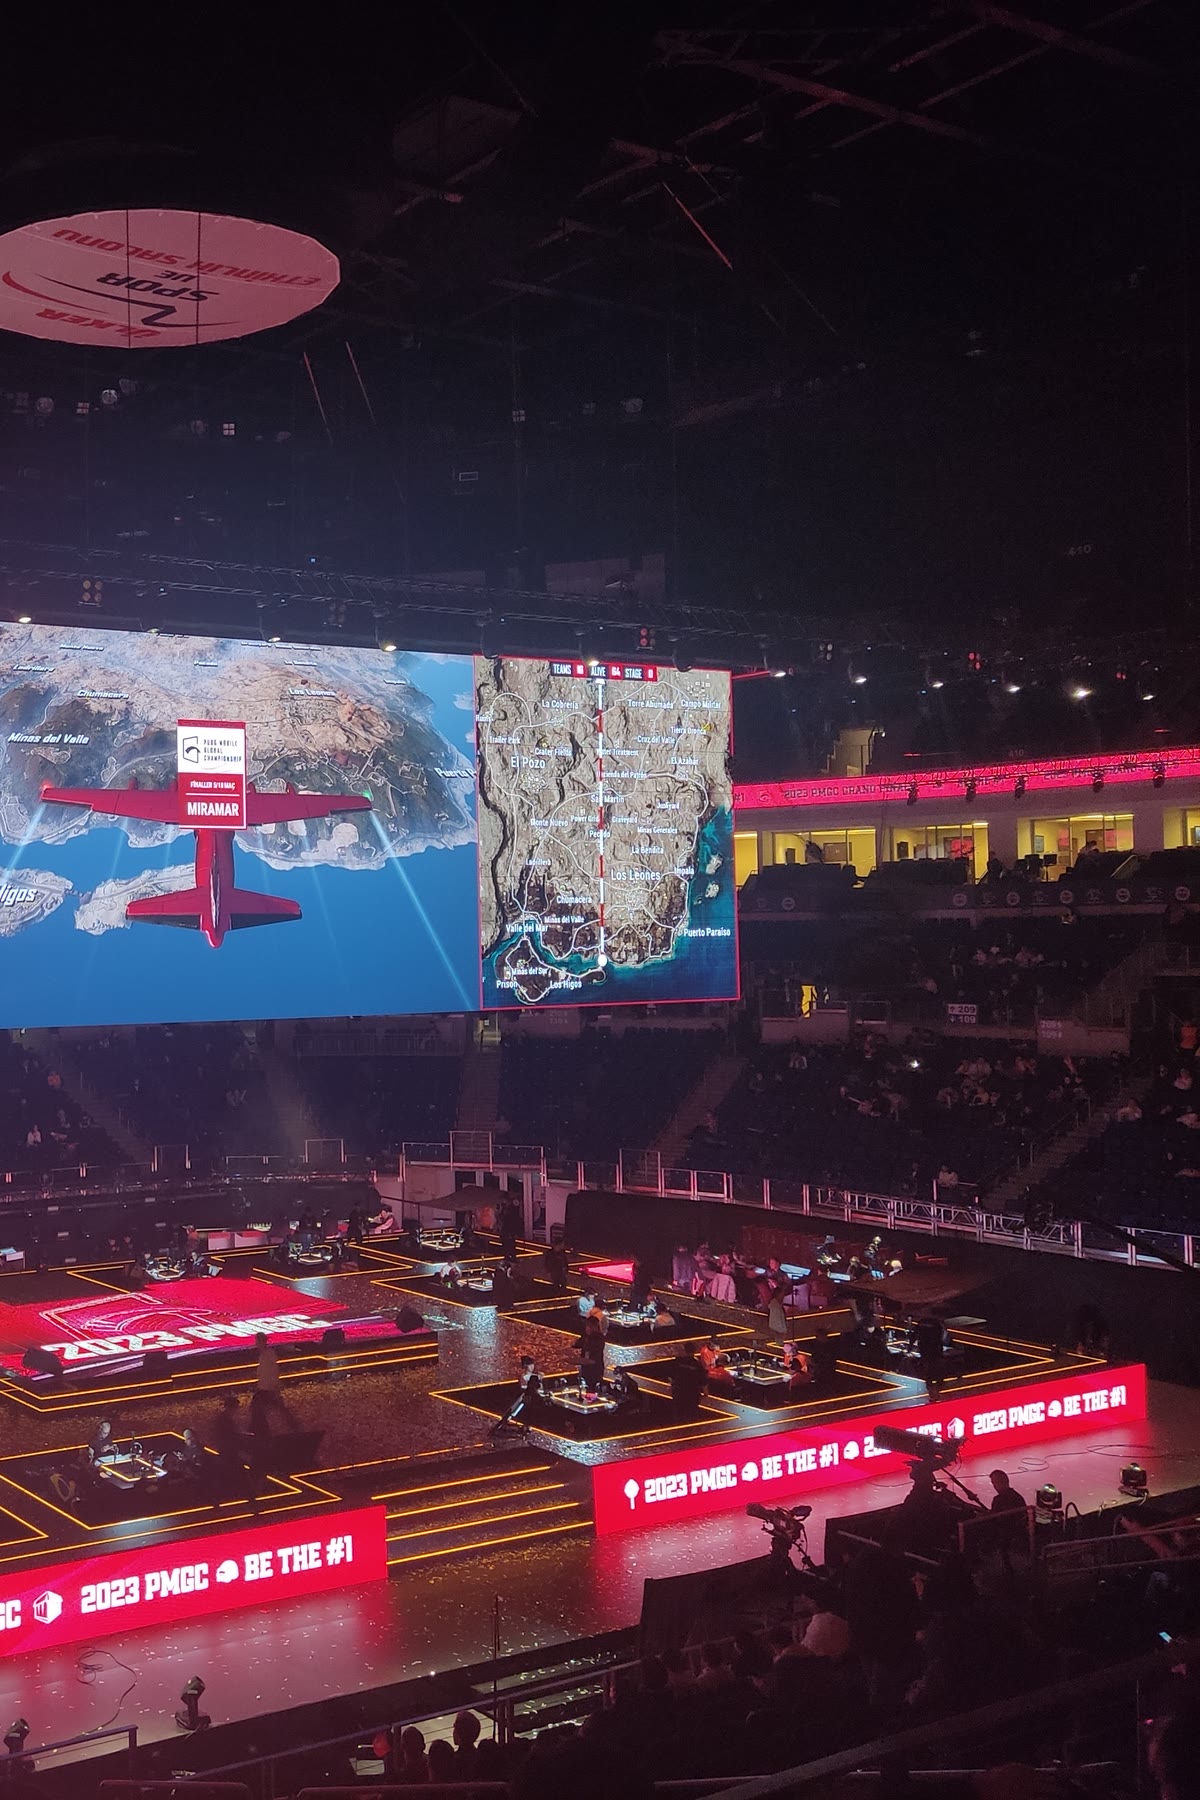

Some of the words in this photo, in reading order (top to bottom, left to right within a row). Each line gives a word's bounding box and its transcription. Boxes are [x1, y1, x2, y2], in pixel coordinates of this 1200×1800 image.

[51, 228, 188, 266] SALONU
[96, 271, 221, 303] SPOR
[35, 308, 161, 339] ÜLKER
[553, 663, 572, 675] TEAMS
[590, 665, 606, 677] ALIVE
[611, 666, 621, 676] 64
[625, 668, 643, 679] STAGE
[542, 699, 551, 708] La
[628, 699, 645, 708] Torre
[645, 700, 674, 709] Ahumada
[680, 700, 701, 709] Campo
[702, 700, 722, 709] Militar
[671, 726, 687, 734] Tierra
[7, 732, 41, 743] Minas
[42, 733, 62, 744] del
[63, 734, 91, 745] Valle
[508, 736, 521, 744] Park
[637, 735, 651, 743] Cruz
[651, 736, 660, 744] del
[660, 736, 676, 744] Valle
[203, 755, 242, 763] CHAMPIONSHIP
[511, 756, 520, 768] El
[522, 757, 546, 769] Pozo
[621, 771, 631, 779] del
[783, 787, 808, 798] 2023
[811, 786, 839, 798] PMGC
[842, 784, 876, 797] GRAND
[187, 801, 240, 817] MIRAMAR
[530, 818, 549, 827] Monte
[549, 819, 569, 827] Nuevo
[570, 815, 588, 823] Power
[637, 826, 653, 834] Minas
[632, 846, 643, 854] La
[611, 869, 627, 881] Los
[629, 870, 661, 881] Leones
[674, 866, 695, 876] Impala
[556, 895, 593, 905] Chumacera
[544, 916, 561, 924] Minas
[561, 916, 570, 924] del
[570, 916, 585, 924] Valle
[505, 923, 522, 933] Valle
[524, 923, 535, 933] del
[535, 924, 549, 933] Mar
[683, 928, 706, 937] Puerto
[706, 926, 731, 937] Paraíso
[511, 968, 528, 976] Minas
[528, 968, 537, 976] del
[496, 980, 518, 989] Prison
[550, 980, 562, 990] Los
[563, 980, 583, 991] Higos
[958, 1006, 976, 1014] 209
[958, 1015, 976, 1024] 109
[40, 1329, 194, 1361] 2023
[179, 1314, 333, 1343] PMGC
[972, 1408, 1007, 1437] 2023
[1009, 1402, 1046, 1429] PMGC
[1063, 1395, 1082, 1418] BE
[1082, 1388, 1110, 1413] THE
[1110, 1384, 1127, 1409] #1
[644, 1472, 689, 1504] 2023
[690, 1463, 738, 1496] PMGC
[762, 1454, 784, 1482] BE
[785, 1447, 818, 1476] THE
[818, 1441, 840, 1469] #1
[80, 1578, 141, 1615] 2023
[144, 1562, 210, 1601] PMGC
[242, 1550, 274, 1583] BE
[277, 1540, 324, 1576] THE
[325, 1534, 355, 1567] #1
